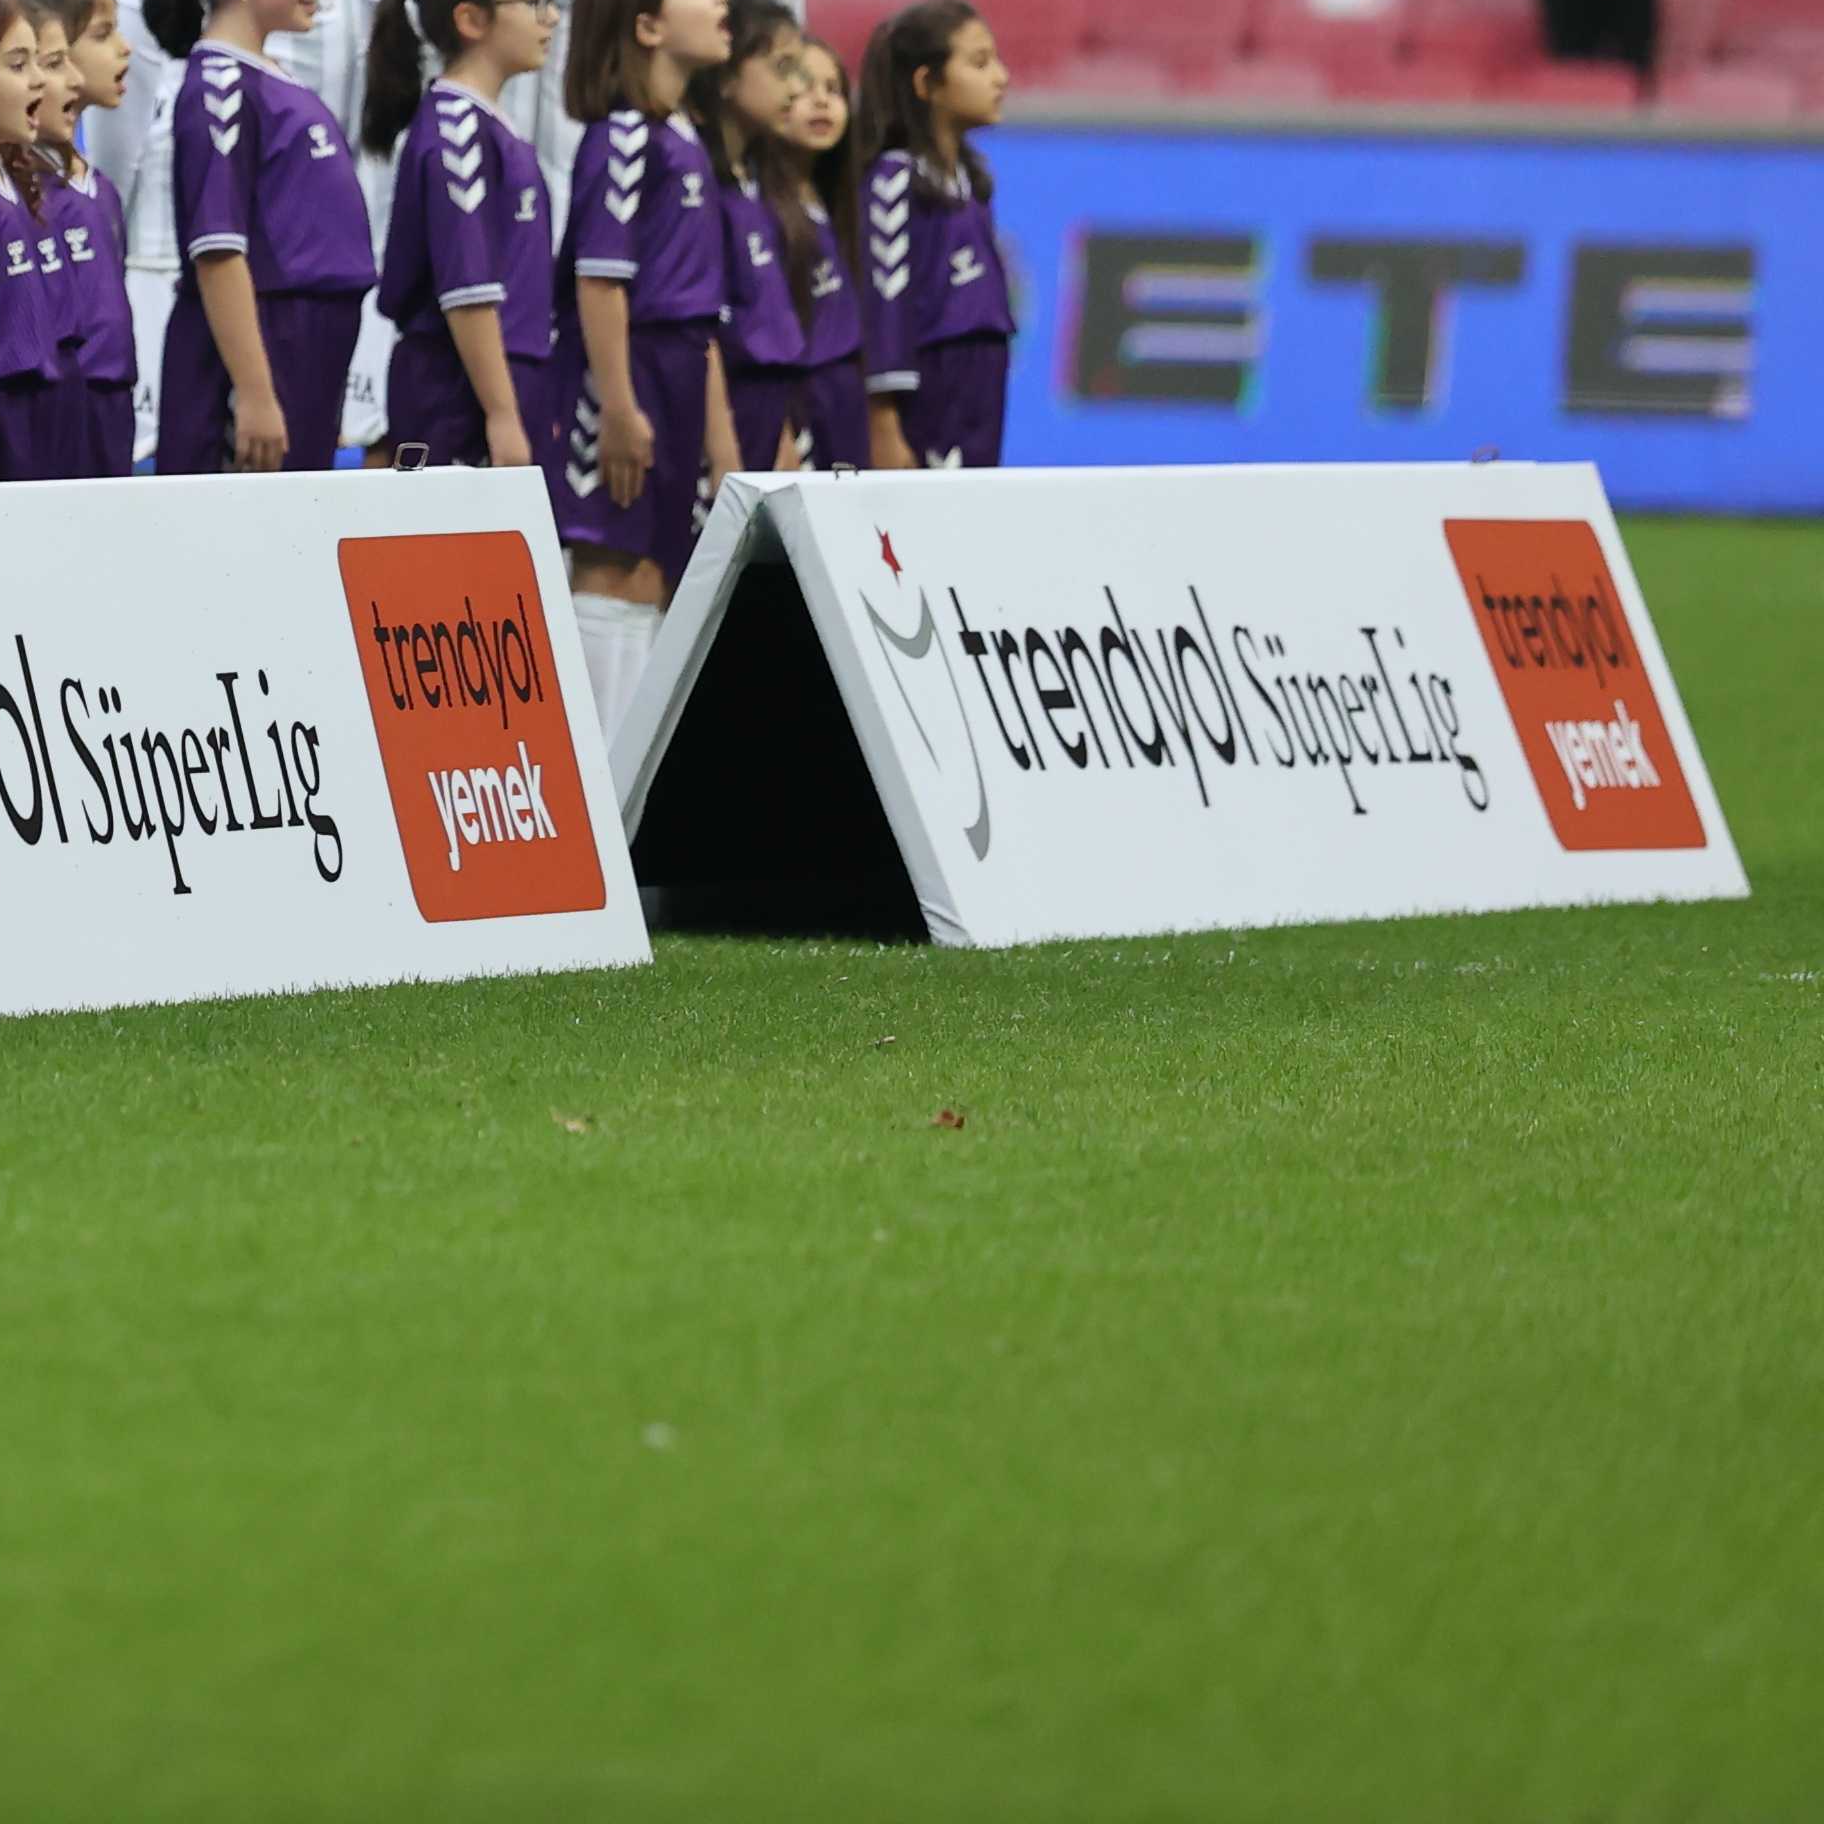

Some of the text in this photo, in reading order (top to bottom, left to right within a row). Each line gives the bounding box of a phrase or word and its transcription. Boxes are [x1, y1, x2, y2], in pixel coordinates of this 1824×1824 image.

[1064, 229, 1758, 419] ETE
[371, 591, 546, 731] trendyol
[949, 586, 1260, 808] trendyol
[1479, 575, 1631, 686] trendyol
[428, 741, 559, 873] yemek
[1546, 699, 1662, 812] yemek
